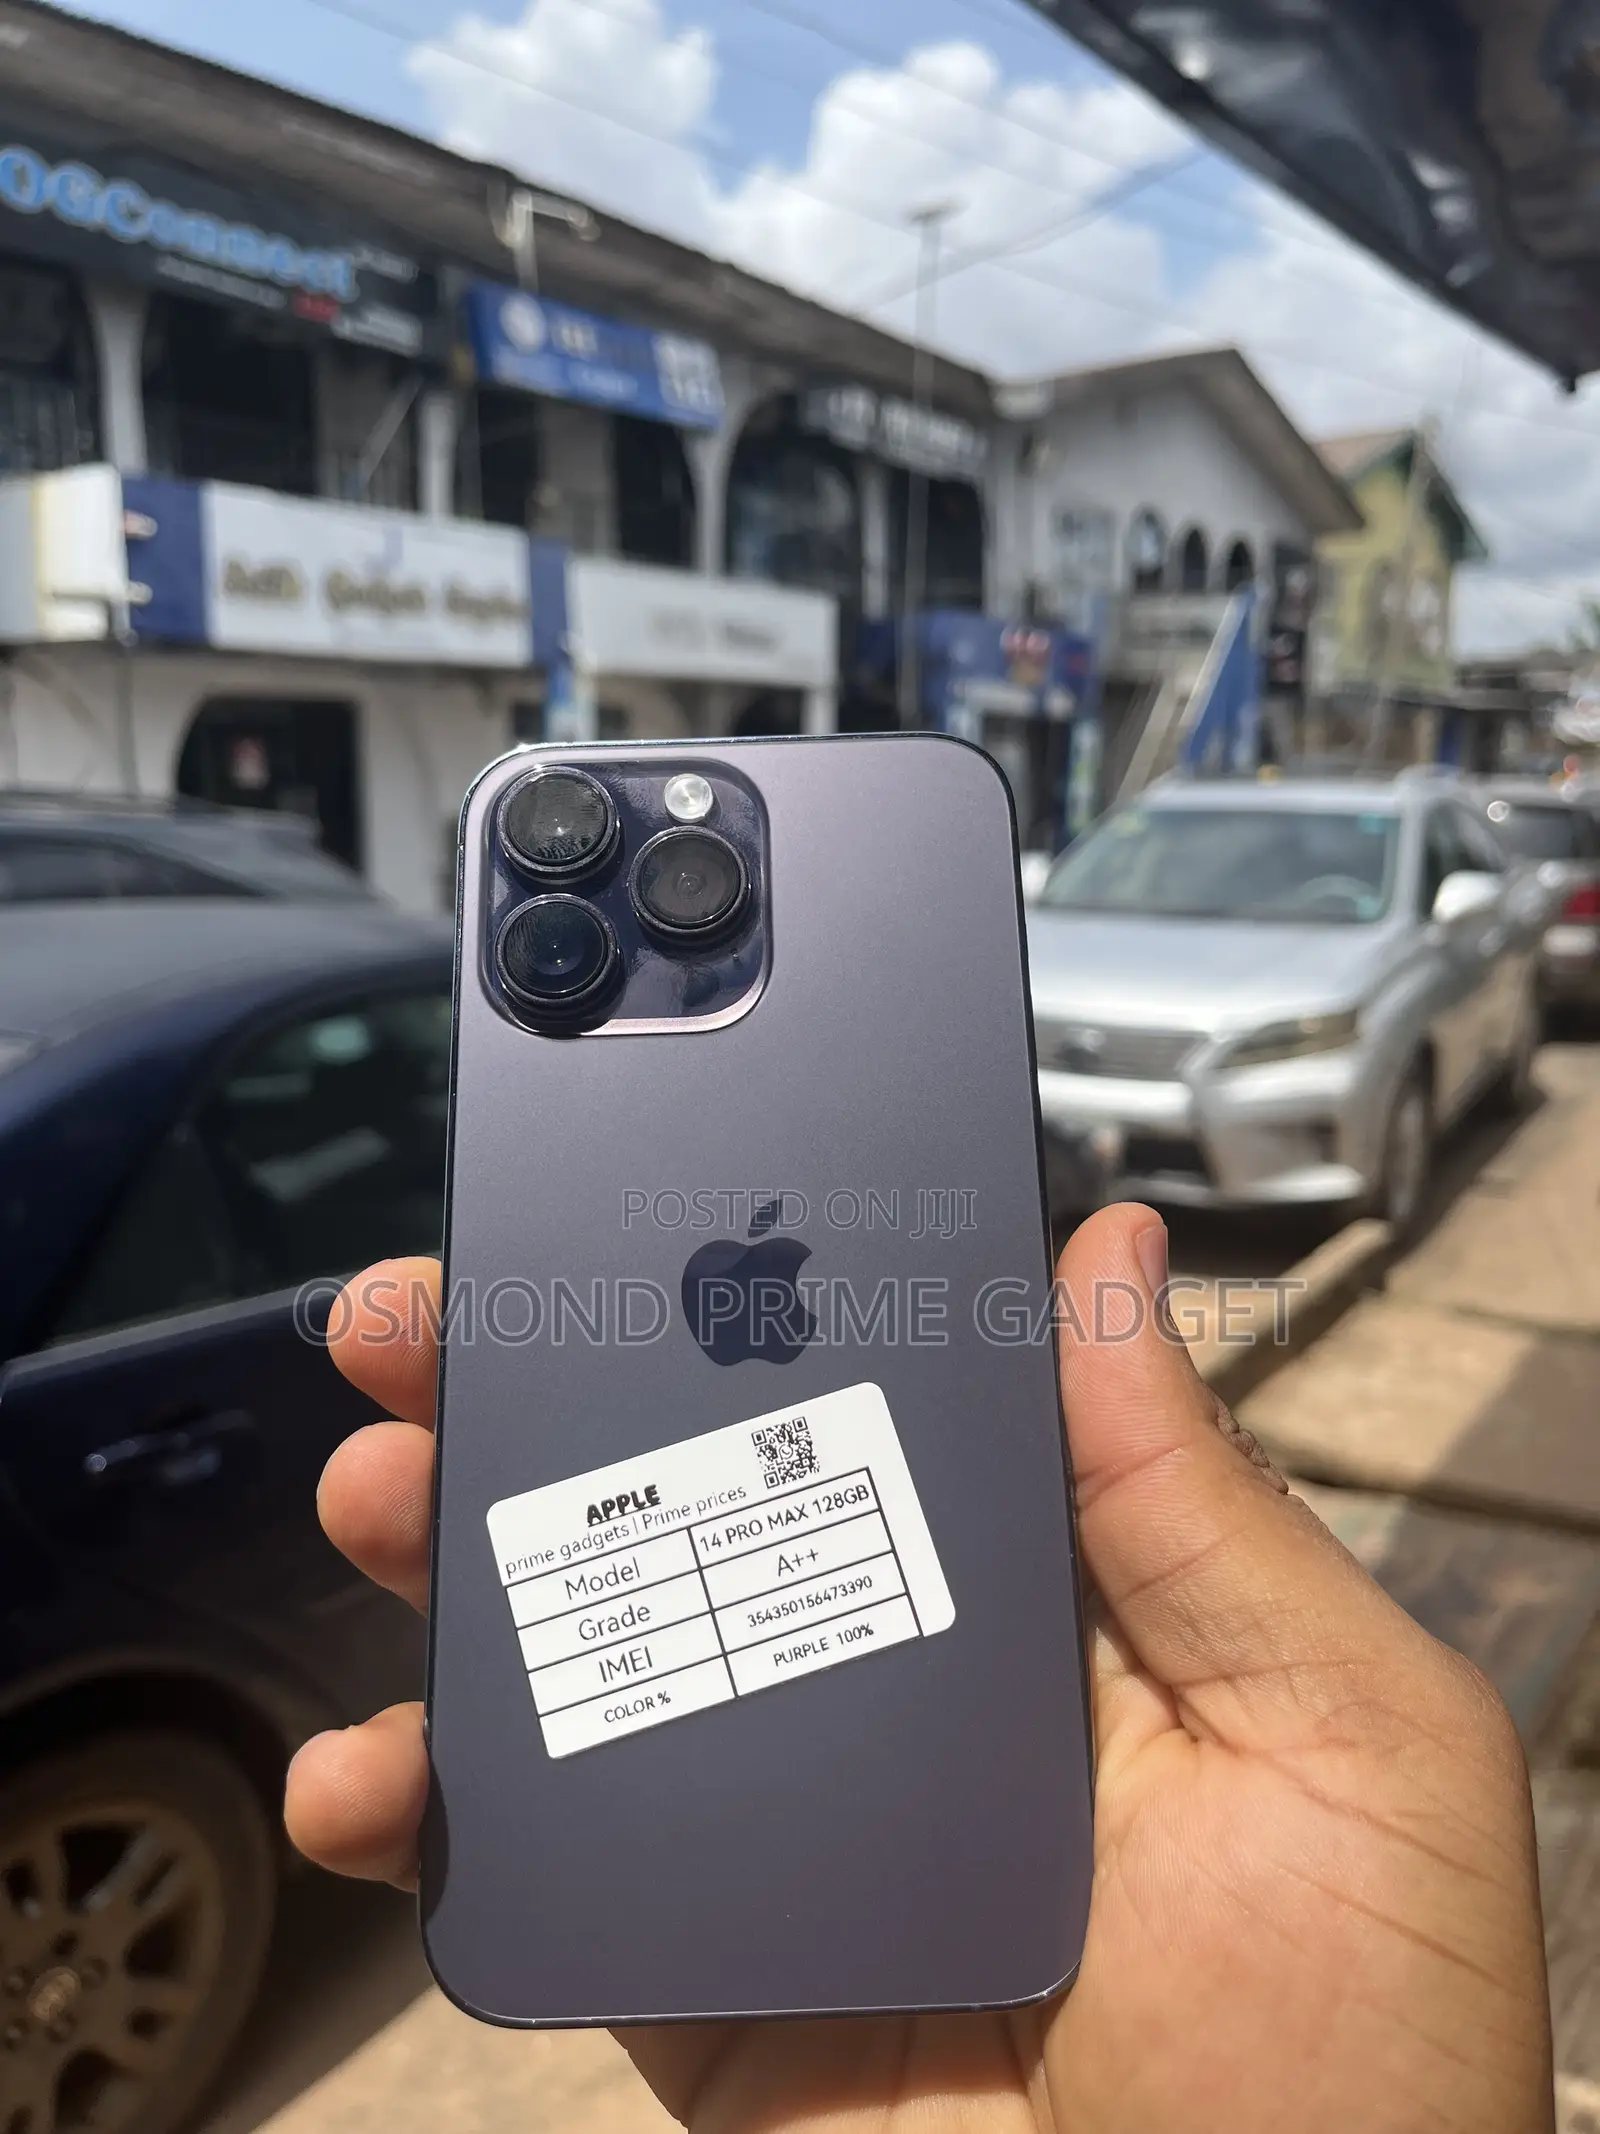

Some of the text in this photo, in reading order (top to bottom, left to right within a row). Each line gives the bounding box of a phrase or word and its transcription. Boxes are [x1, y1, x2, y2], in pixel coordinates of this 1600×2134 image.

[586, 1484, 661, 1527] APPLE
[700, 1484, 870, 1552] 14 PRO MAX 128GB
[505, 1547, 555, 1579] prime
[559, 1522, 630, 1561] gadgets
[641, 1503, 691, 1530] Prime
[696, 1485, 747, 1516] prices
[565, 1556, 641, 1600] Model
[776, 1547, 819, 1577] A++
[578, 1603, 651, 1640] Grade
[747, 1575, 873, 1628] 354350156473390
[598, 1645, 653, 1683] IMEI
[773, 1622, 875, 1667] PURPLE 100%
[604, 1690, 671, 1722] COLOR %
